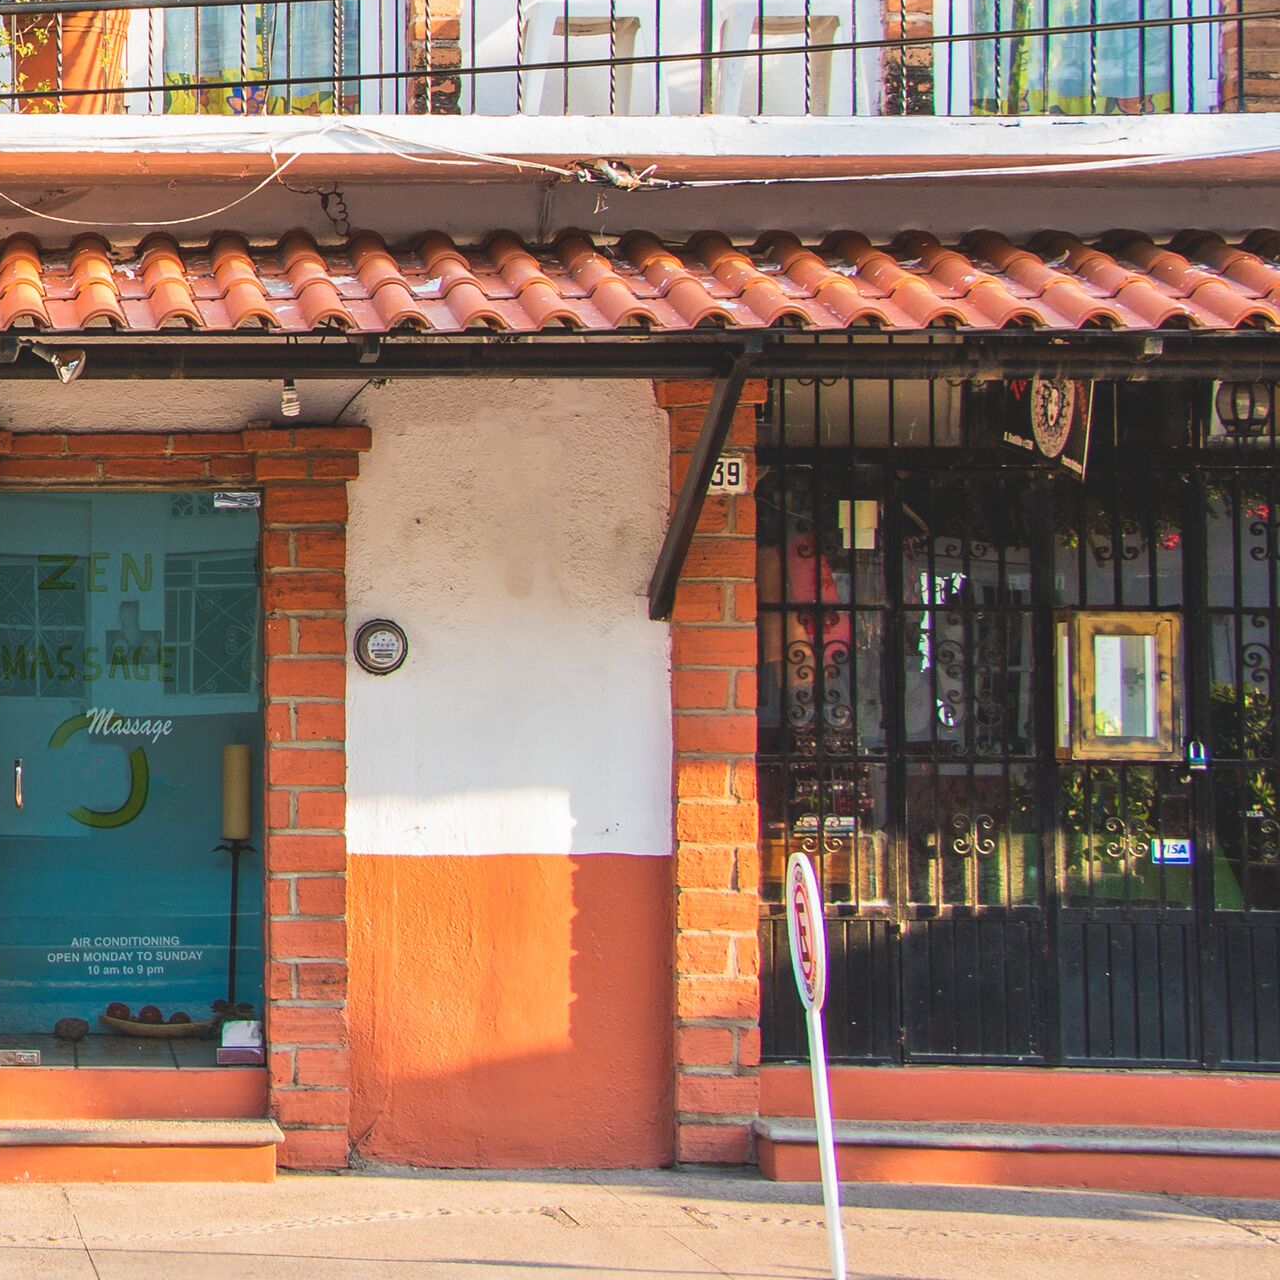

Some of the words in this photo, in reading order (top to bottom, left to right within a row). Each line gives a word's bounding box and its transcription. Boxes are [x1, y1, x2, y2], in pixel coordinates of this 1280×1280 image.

[38, 552, 153, 592] ZEN
[1, 644, 177, 683] MASSAGE
[86, 706, 173, 743] Massage
[71, 937, 91, 948] AIR
[94, 936, 180, 947] CONDITIONING
[47, 952, 80, 963] OPEN
[83, 951, 133, 962] MONDAY
[137, 951, 153, 962] TO
[156, 950, 204, 961] SUNDAY
[88, 965, 100, 975] 10
[103, 966, 120, 975] am
[123, 965, 134, 975] to
[137, 964, 143, 975] 9
[147, 966, 164, 977] pm
